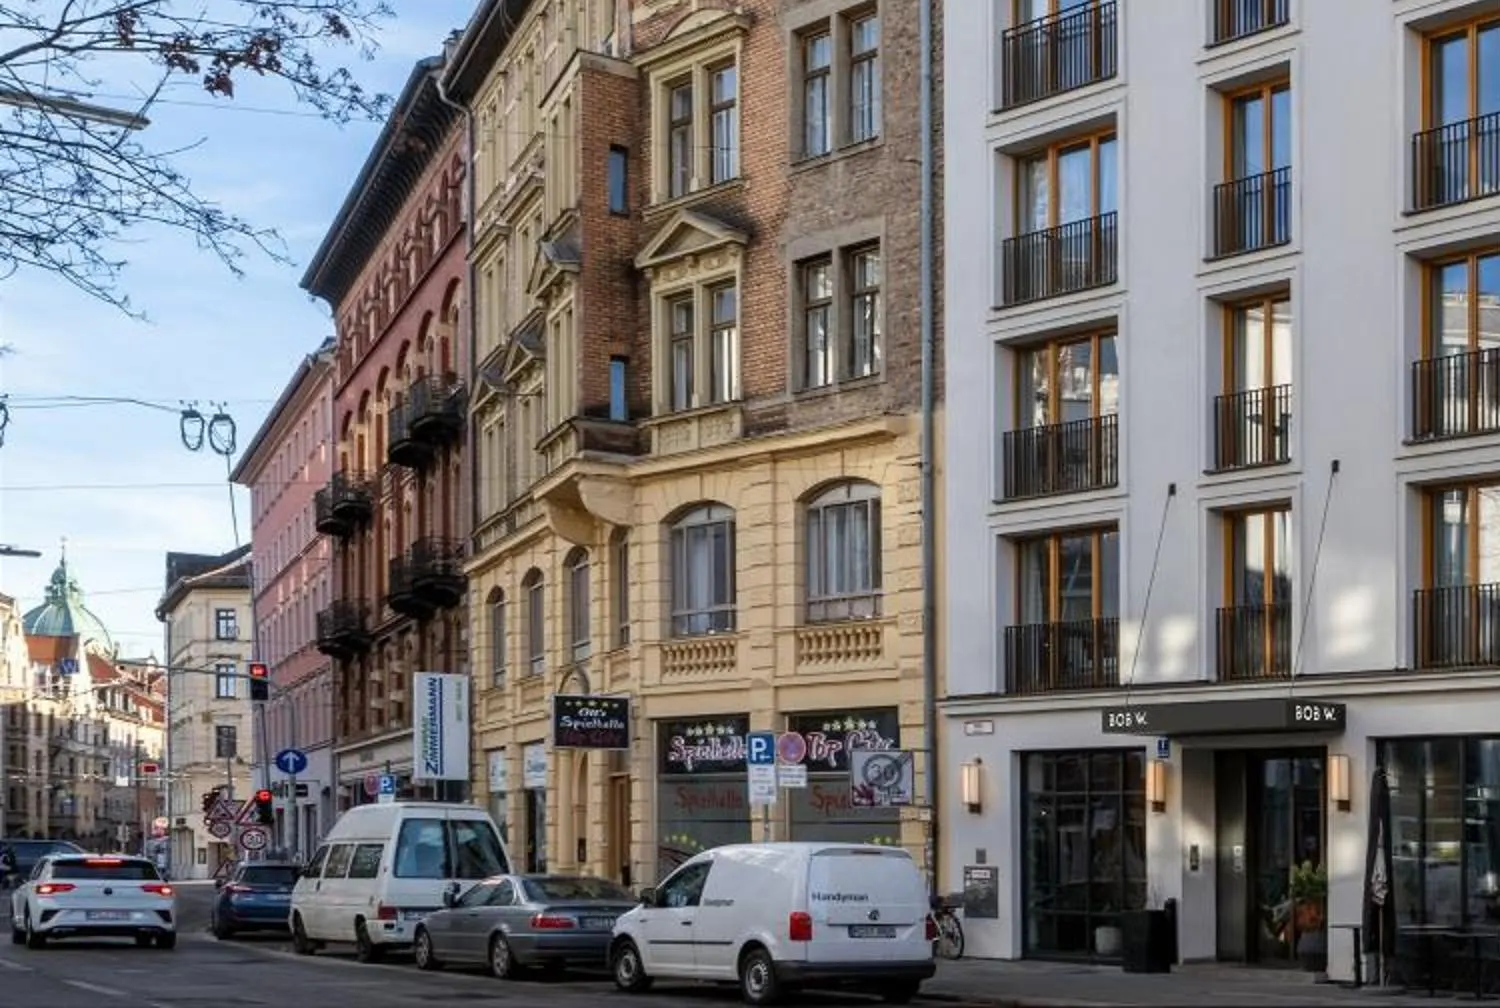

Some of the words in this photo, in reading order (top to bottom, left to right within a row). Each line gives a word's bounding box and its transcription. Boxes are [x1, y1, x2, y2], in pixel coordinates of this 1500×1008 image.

[1108, 712, 1132, 727] BOB
[1133, 711, 1148, 725] W.
[1295, 705, 1320, 721] BOB
[1323, 707, 1337, 721] W.
[425, 677, 439, 775] ZIMMERMANN
[559, 715, 625, 730] Spielhalle
[751, 737, 767, 761] P
[806, 732, 843, 768] Top
[811, 891, 869, 904] Handyman
